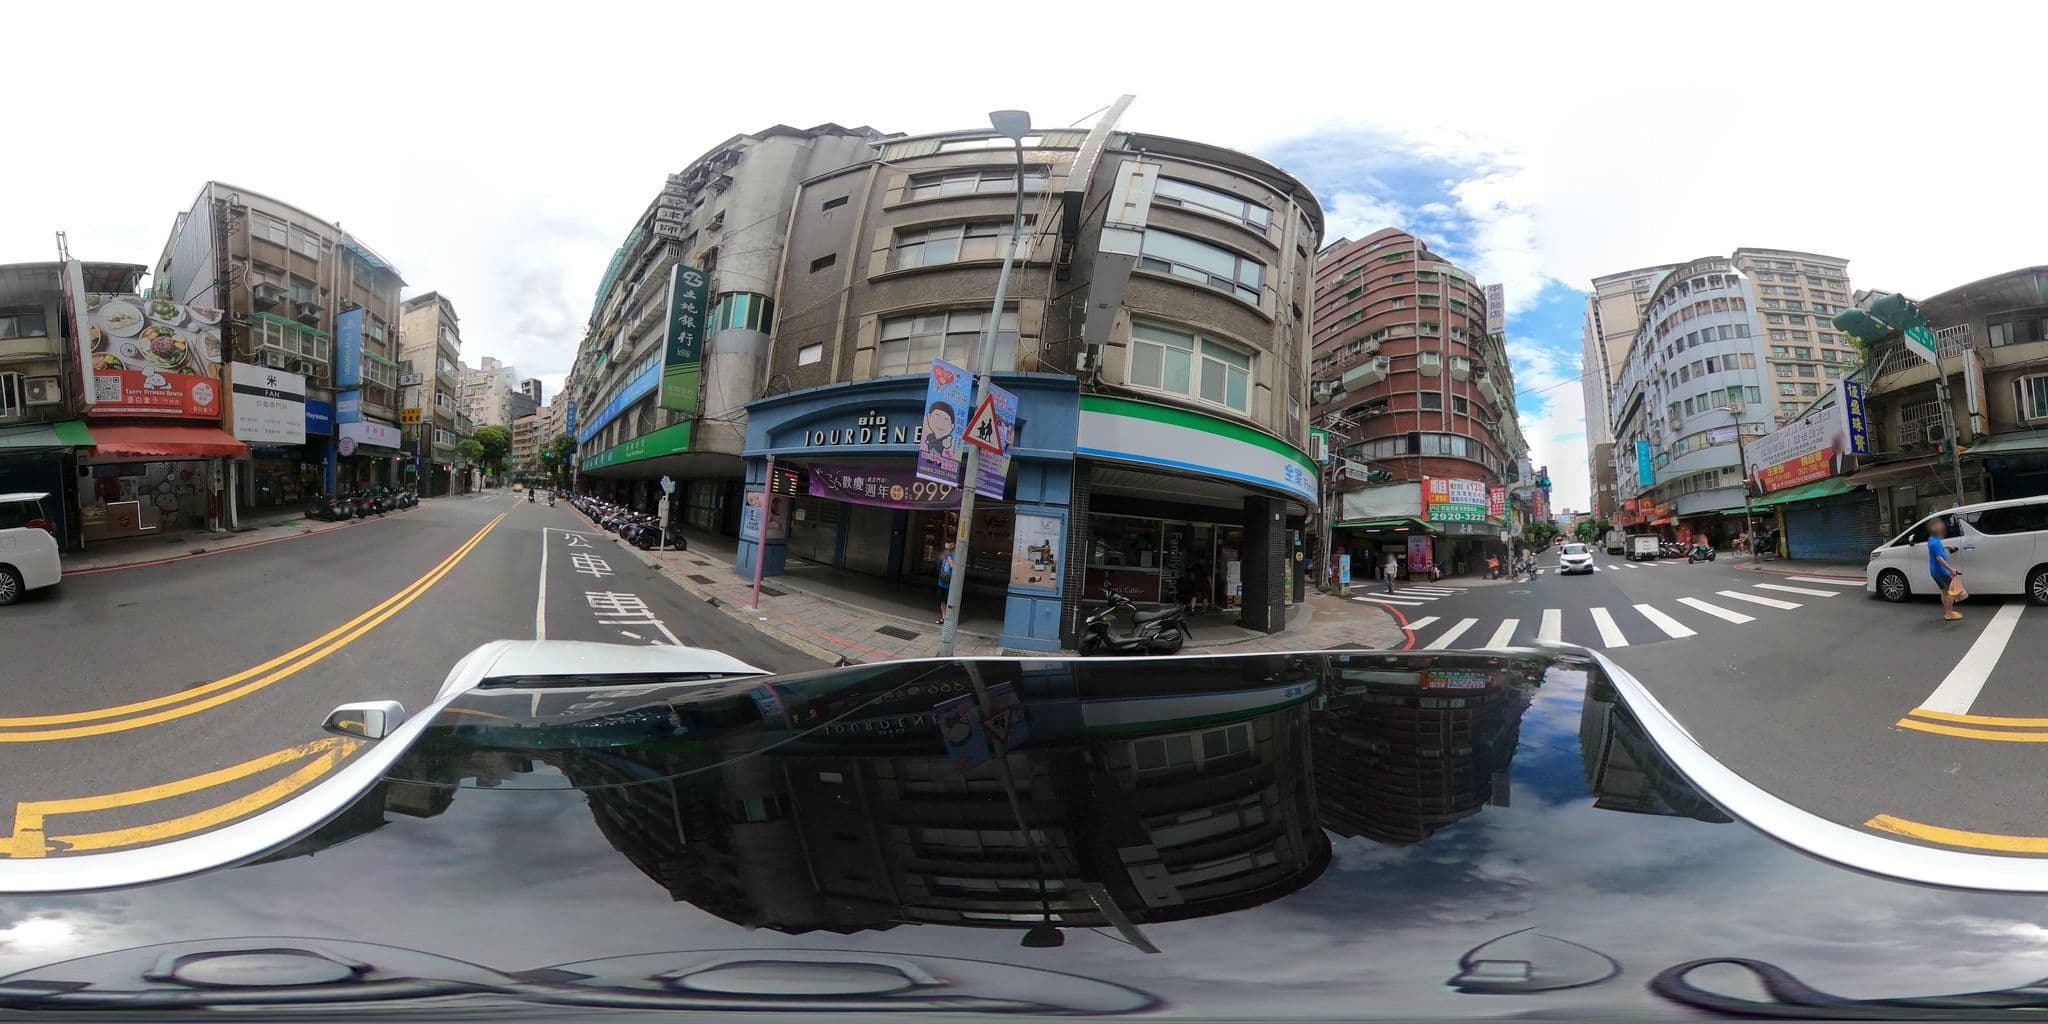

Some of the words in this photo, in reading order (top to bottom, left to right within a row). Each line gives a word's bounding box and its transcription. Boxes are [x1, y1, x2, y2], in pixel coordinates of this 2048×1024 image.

[677, 290, 698, 347] 土地銀行
[267, 374, 277, 387] 米
[264, 390, 280, 399] FAN
[1284, 464, 1302, 484] 全家
[912, 482, 952, 501] 999
